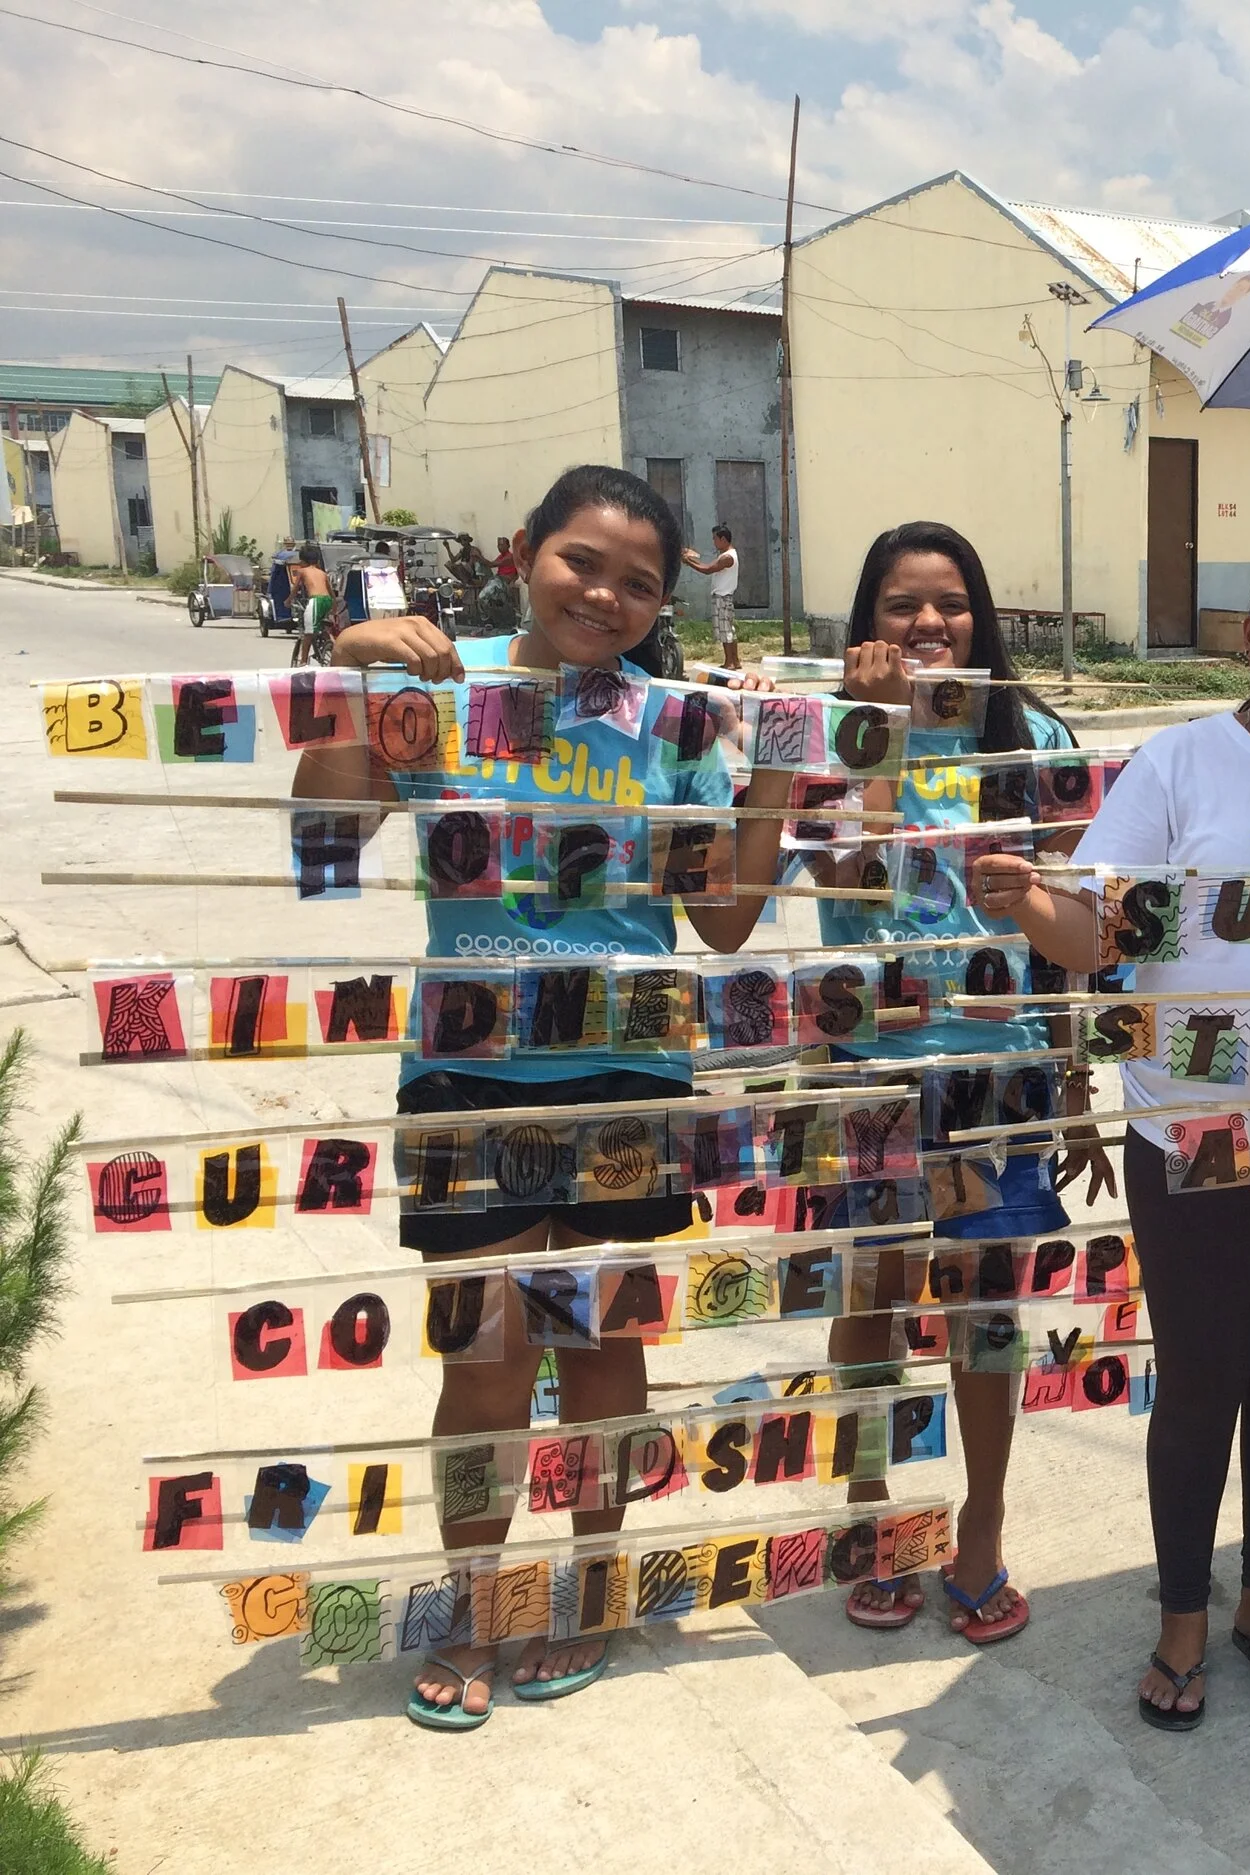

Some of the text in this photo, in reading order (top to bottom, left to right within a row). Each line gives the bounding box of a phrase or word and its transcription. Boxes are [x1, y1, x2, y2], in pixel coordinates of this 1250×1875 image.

[532, 737, 646, 806] Club
[300, 808, 718, 899] HOPE
[102, 965, 866, 1060] KINDNESS
[99, 1098, 910, 1225] CURIOSITY
[233, 1246, 834, 1372] COURAGE
[151, 1395, 935, 1552] FRIENDSHIP
[241, 1527, 934, 1654] CONFIDENCE
